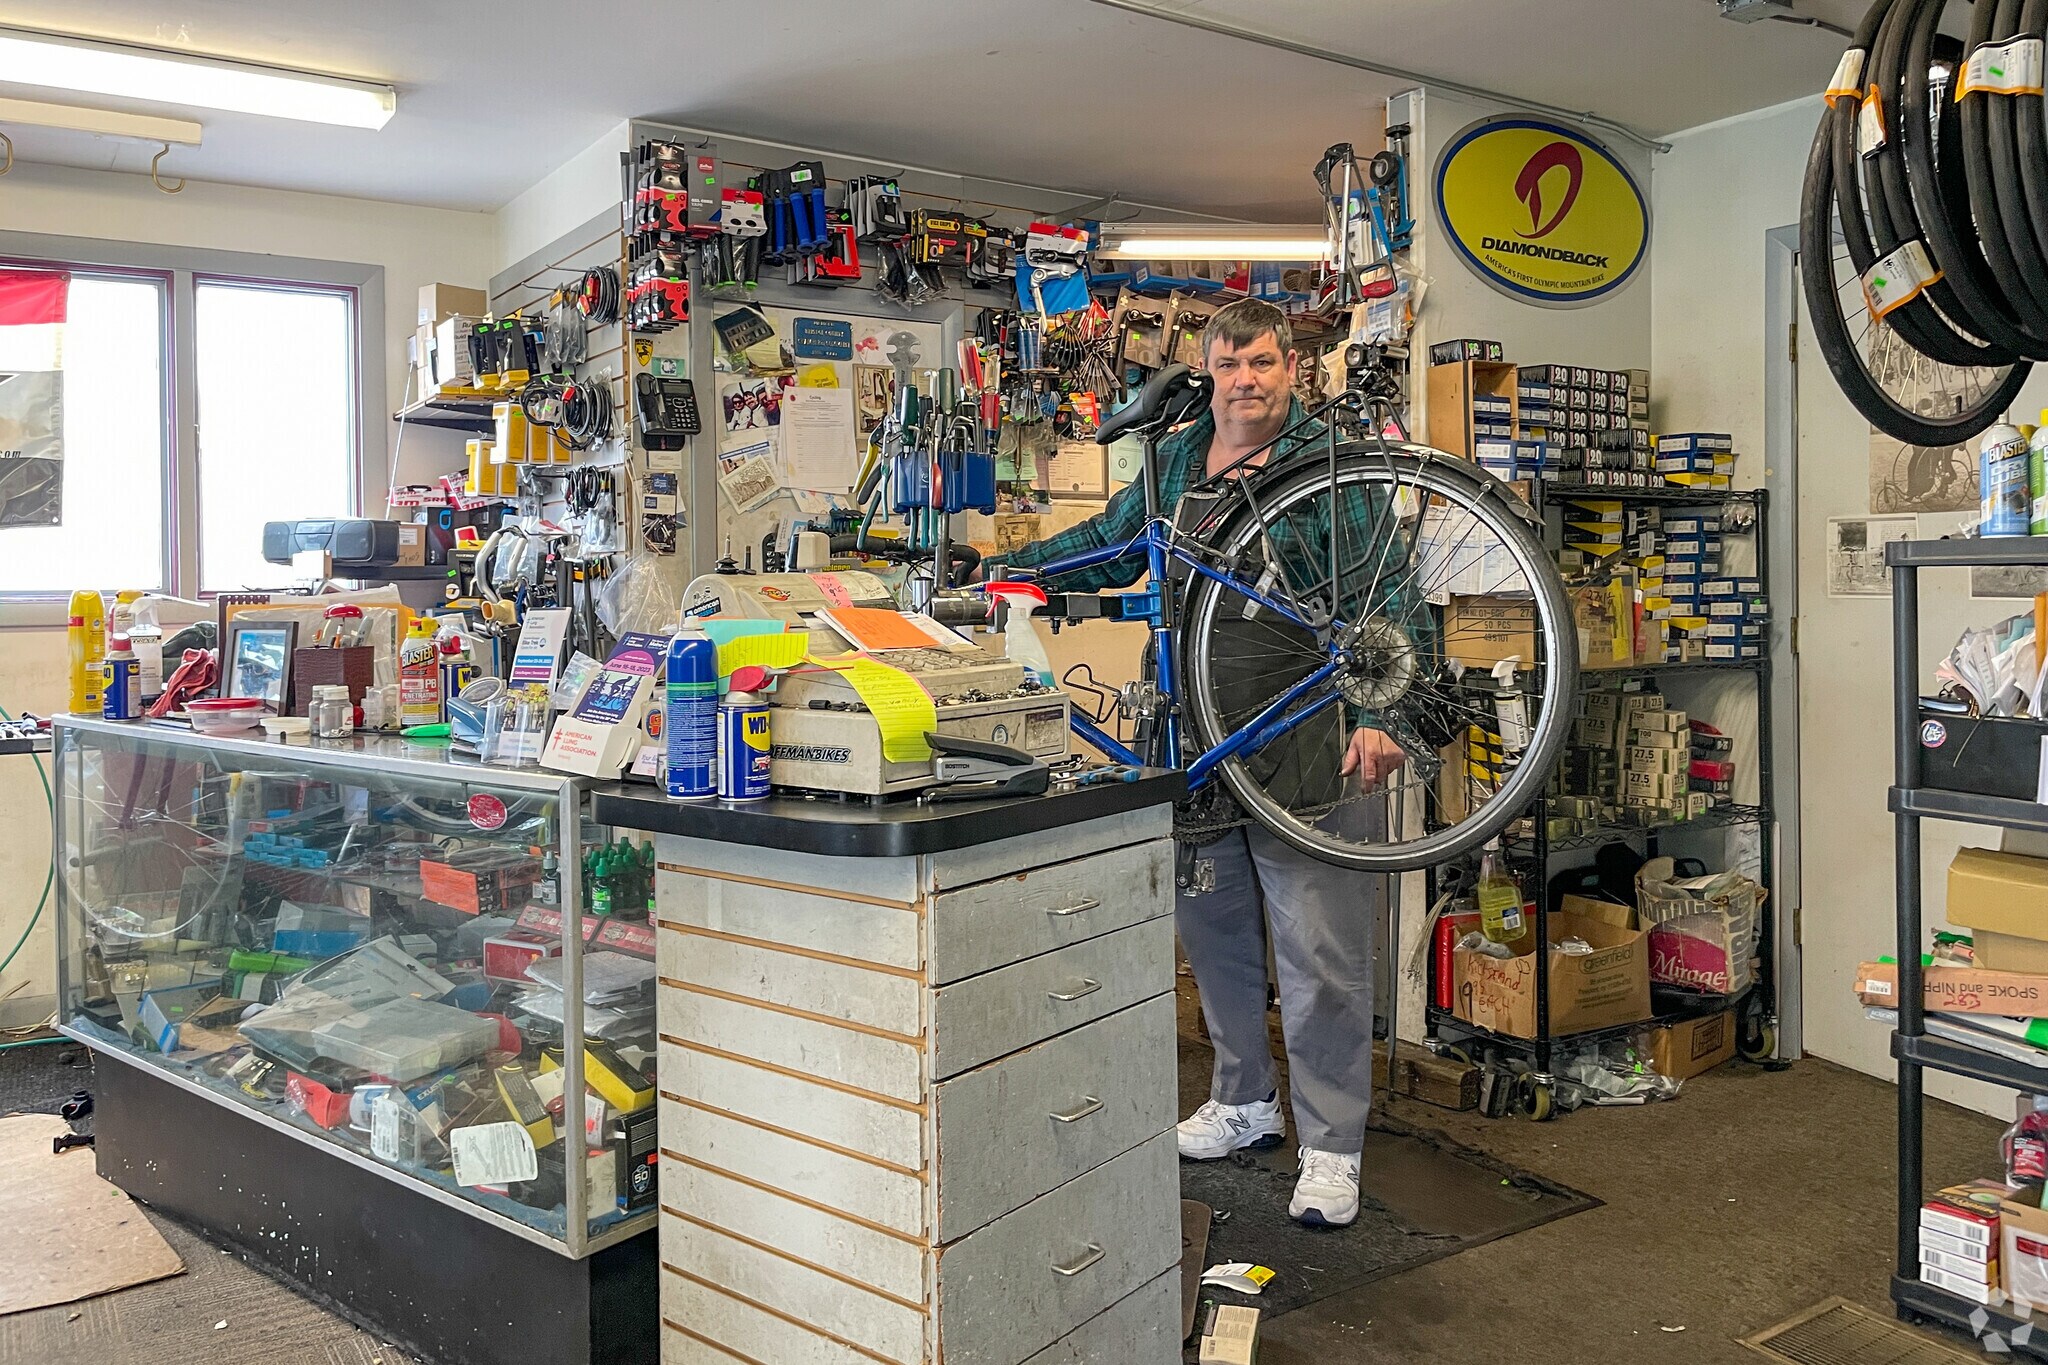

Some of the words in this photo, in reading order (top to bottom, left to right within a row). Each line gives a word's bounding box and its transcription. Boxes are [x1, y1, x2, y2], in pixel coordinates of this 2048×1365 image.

[1481, 236, 1609, 268] DIAMONDBACK
[1484, 254, 1517, 278] AMERICA'S
[1516, 272, 1534, 284] FIRST
[1534, 277, 1560, 289] OLYMPIC
[1560, 278, 1592, 289] MOUNTAIN
[1592, 273, 1606, 285] BIKE
[1554, 367, 1568, 382] 20
[1575, 368, 1588, 384] 20
[1596, 371, 1608, 386] 20
[1615, 375, 1627, 389] 20
[1554, 388, 1567, 403] 20
[1574, 391, 1587, 405] 20
[1594, 393, 1607, 407] 20
[1614, 395, 1625, 410] 20
[1554, 411, 1566, 425] 20
[1574, 412, 1586, 427] 20
[1594, 414, 1607, 428] 20
[1615, 416, 1627, 429] 20
[1553, 432, 1566, 444] 20
[1574, 433, 1586, 447] 20
[1637, 430, 1647, 446] 20
[1590, 449, 1602, 464] 20
[1637, 452, 1646, 466] 20
[1991, 458, 2027, 474] DRY
[1592, 472, 1604, 485] 20
[1613, 473, 1625, 486] 20
[1632, 473, 1645, 487] 20
[1653, 475, 1664, 488] 20
[1991, 467, 2027, 486] LUBE
[1484, 620, 1491, 629] 50
[1497, 620, 1511, 629] PCS
[401, 644, 434, 667] BLASTER
[425, 678, 437, 689] PB
[1591, 694, 1609, 705] 27.5
[1631, 699, 1641, 708] 27.5
[1651, 698, 1662, 707] 27.5
[1587, 718, 1605, 728] 27.5
[565, 731, 593, 741] AMERICAN
[560, 745, 597, 757] ASSOCIATION
[1634, 749, 1654, 759] 27.5
[1679, 751, 1687, 760] 27.5
[1630, 773, 1649, 783] 27.5
[1674, 774, 1684, 785] 27.5
[1693, 796, 1703, 805] 27.5
[1583, 948, 1631, 972] greenfield
[1652, 949, 1728, 987] Mirage
[1959, 983, 1984, 994] and
[1988, 984, 2039, 999] SPOKE
[633, 1170, 649, 1183] 50
